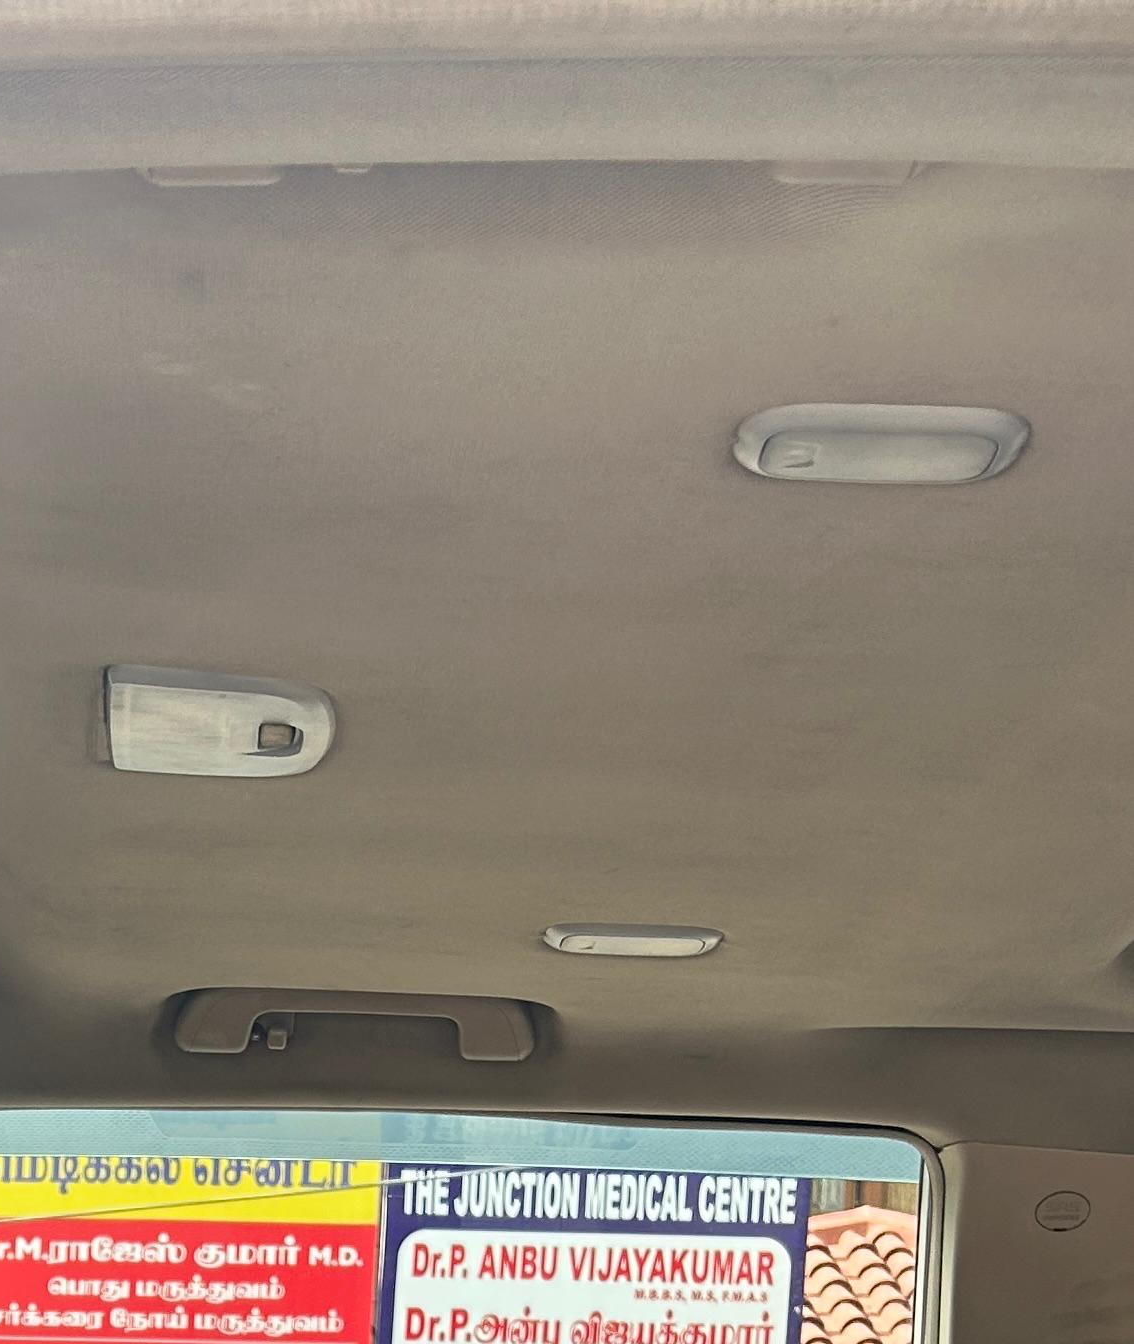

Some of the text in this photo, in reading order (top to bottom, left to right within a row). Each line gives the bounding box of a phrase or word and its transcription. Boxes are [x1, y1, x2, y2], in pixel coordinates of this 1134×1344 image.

[401, 1169, 798, 1224] THE JUNCTION MEDICAL CENTRE
[194, 1234, 302, 1268] குமார்
[309, 1244, 364, 1268] M.D.
[412, 1243, 775, 1286] Dr.P. ANBU VIJAYAKUMAR
[47, 1273, 286, 1304] பொது மருத்துவம்
[109, 1305, 189, 1333] நோய்
[194, 1307, 345, 1337] மருத்துவம்
